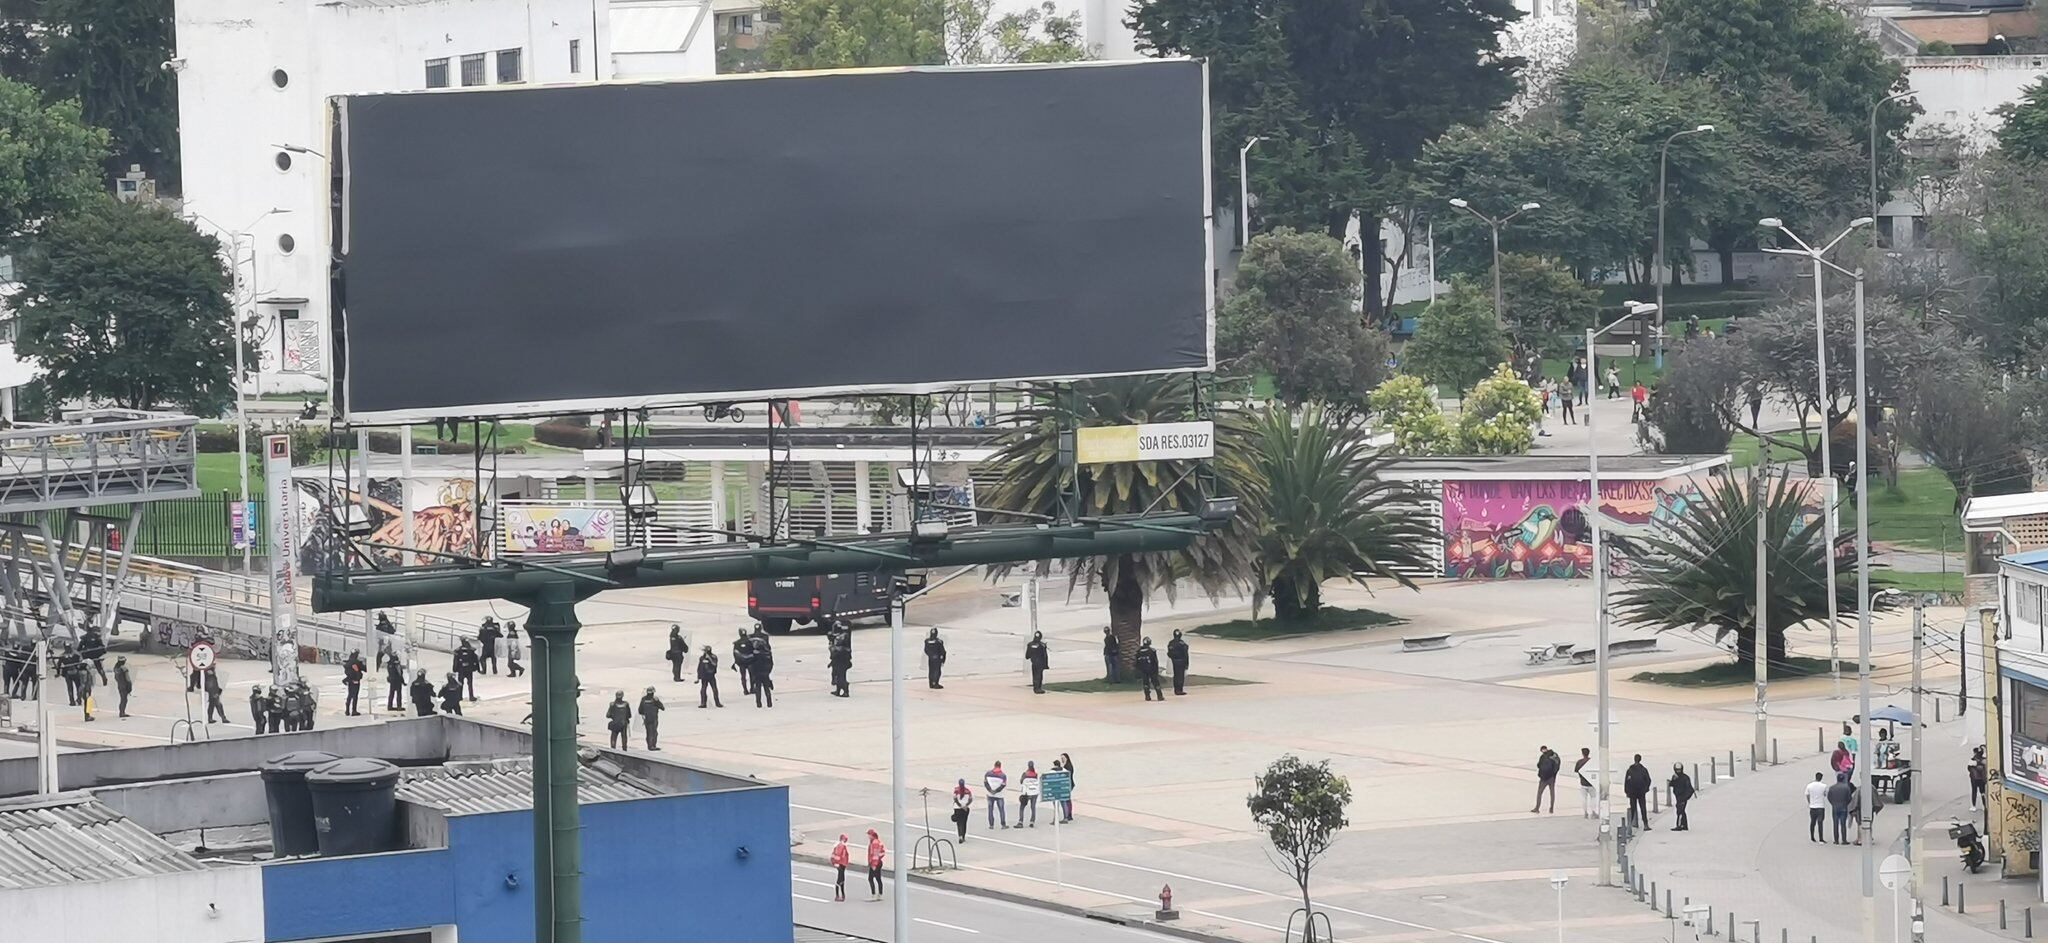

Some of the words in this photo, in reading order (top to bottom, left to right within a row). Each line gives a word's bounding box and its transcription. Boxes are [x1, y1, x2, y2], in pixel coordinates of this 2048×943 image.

[1139, 435, 1159, 451] SDA
[1161, 433, 1209, 450] RES.03127
[1536, 481, 1556, 499] LXS
[1560, 481, 1656, 501] DESAARECIDXS?
[280, 478, 291, 557] Universitaria
